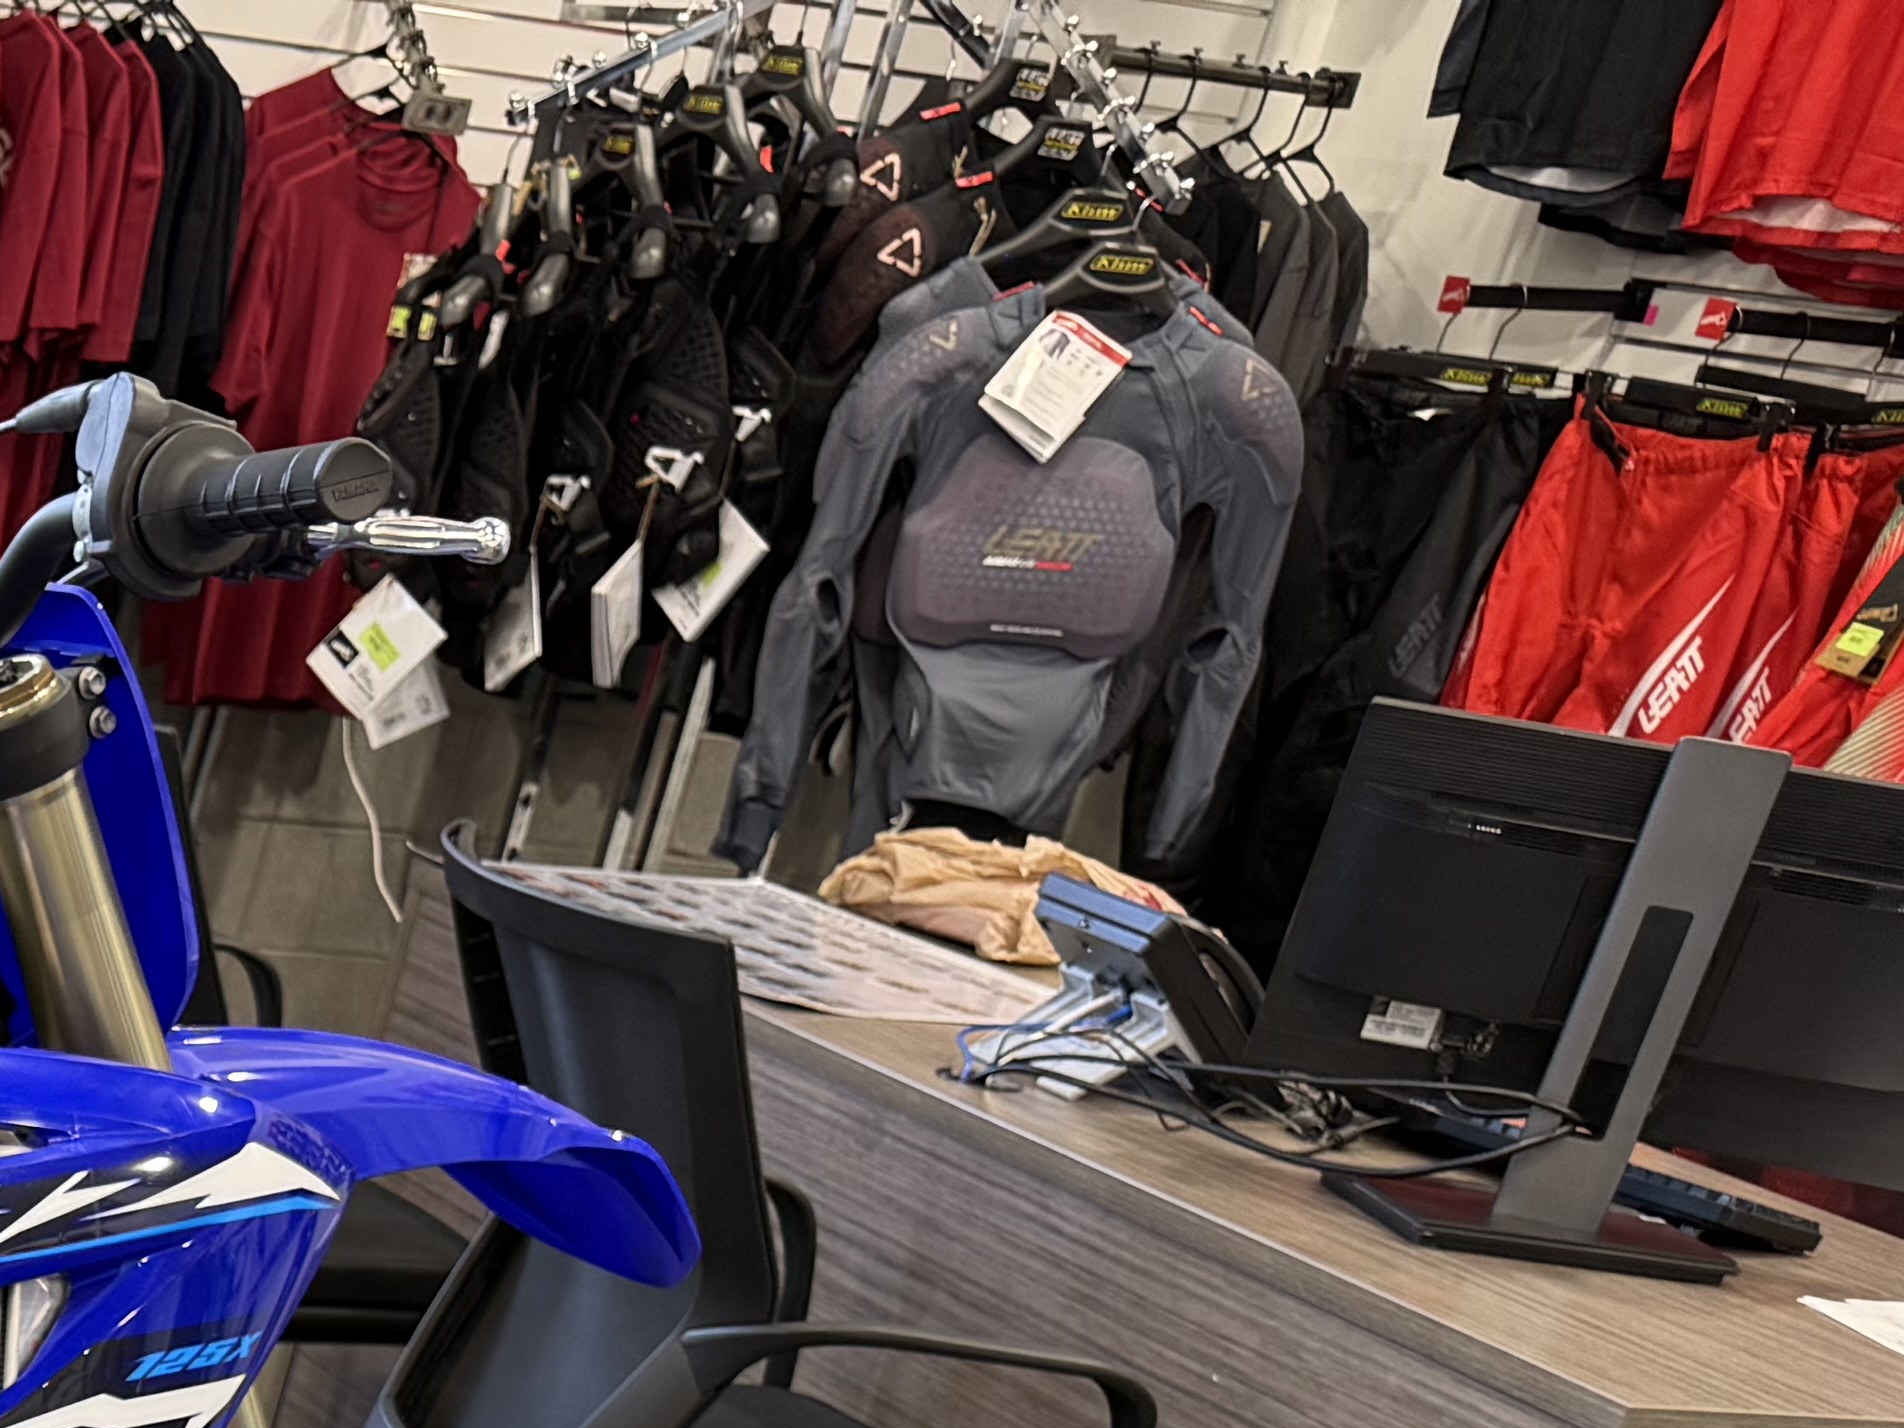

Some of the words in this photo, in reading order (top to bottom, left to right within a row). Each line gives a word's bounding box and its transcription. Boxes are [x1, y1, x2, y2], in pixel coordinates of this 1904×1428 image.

[983, 525, 1105, 562] LEATT
[1638, 635, 1705, 734] LEATT
[1729, 666, 1773, 742] EATT
[125, 1330, 263, 1382] 125X
